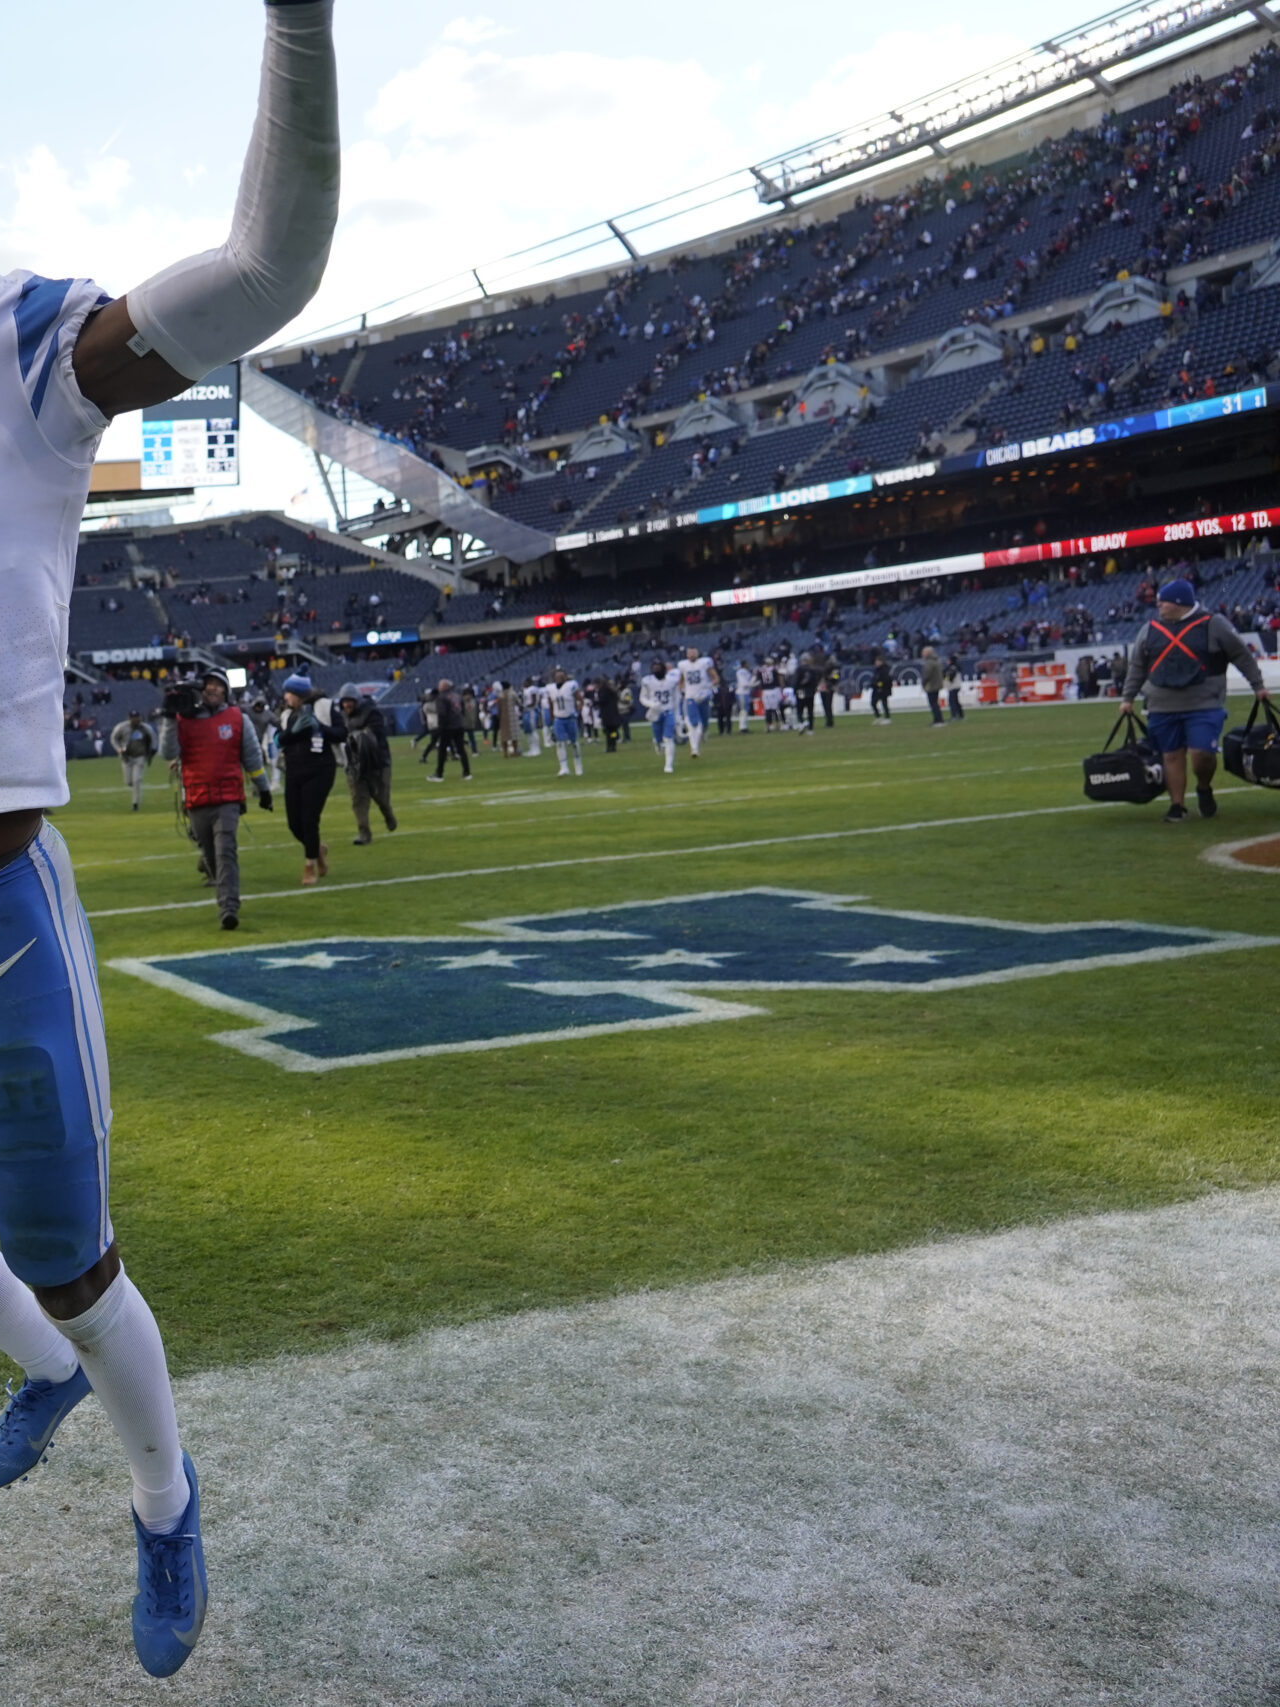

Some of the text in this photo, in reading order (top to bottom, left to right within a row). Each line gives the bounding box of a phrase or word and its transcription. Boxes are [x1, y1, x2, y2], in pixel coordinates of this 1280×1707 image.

[1223, 394, 1242, 414] 31
[875, 427, 1096, 486] VERSUS CHICAGO BEARS
[769, 483, 829, 510] LIONS
[1091, 532, 1128, 552] BRADY
[1196, 518, 1223, 536] YDS.
[1231, 514, 1246, 531] 12
[1251, 511, 1272, 529] TD.
[380, 630, 402, 643] edge
[92, 648, 163, 664] DOWN
[556, 696, 565, 711] 11
[1089, 773, 1130, 785] Wilson
